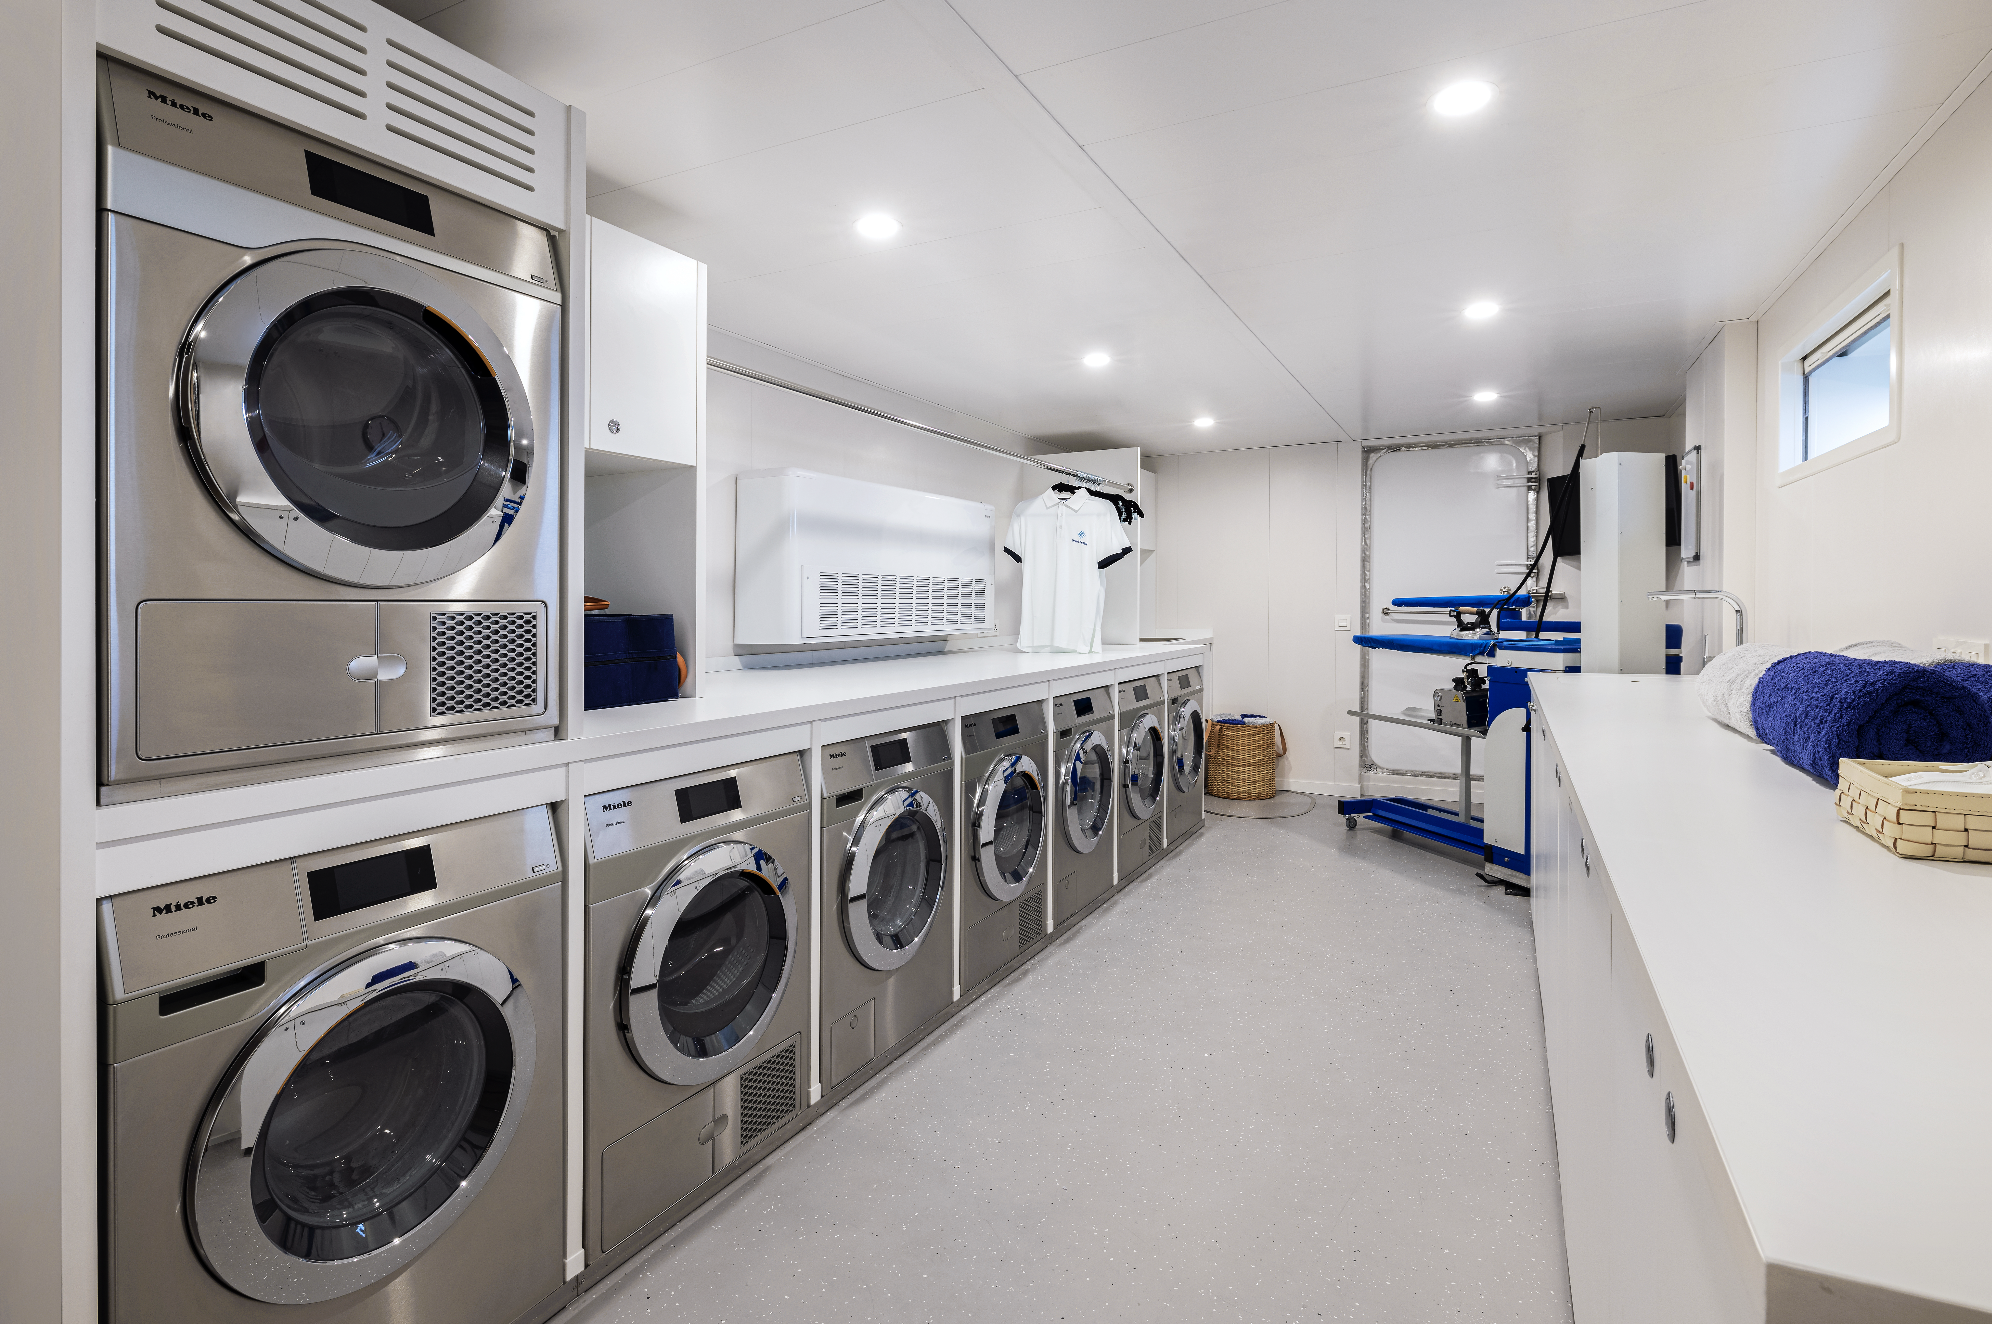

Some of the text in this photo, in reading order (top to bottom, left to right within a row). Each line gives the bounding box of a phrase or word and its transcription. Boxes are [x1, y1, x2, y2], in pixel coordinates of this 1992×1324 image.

[146, 88, 214, 121] Miele
[601, 800, 633, 813] Miele
[151, 895, 218, 918] Miele
